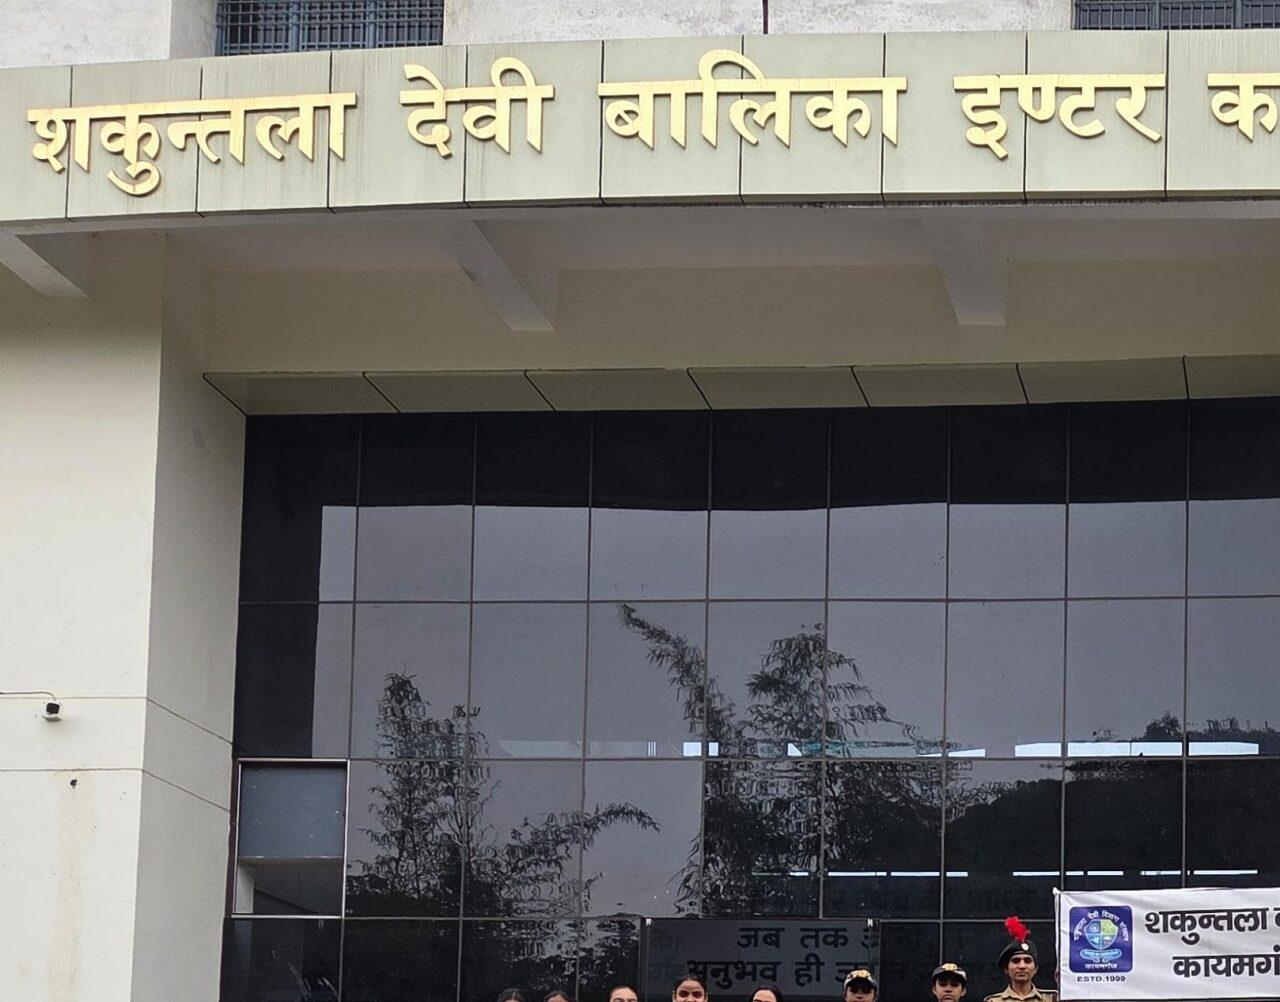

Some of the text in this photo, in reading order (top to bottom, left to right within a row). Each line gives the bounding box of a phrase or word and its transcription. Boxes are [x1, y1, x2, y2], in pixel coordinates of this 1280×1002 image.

[27, 92, 358, 197] शकुन्तला
[400, 57, 554, 157] देवी
[597, 49, 908, 151] बालिका
[953, 73, 1166, 161] इण्टर
[737, 927, 785, 948] जब
[800, 928, 849, 948] तक
[1145, 908, 1269, 946] शकुन्तला
[795, 953, 825, 987] ही
